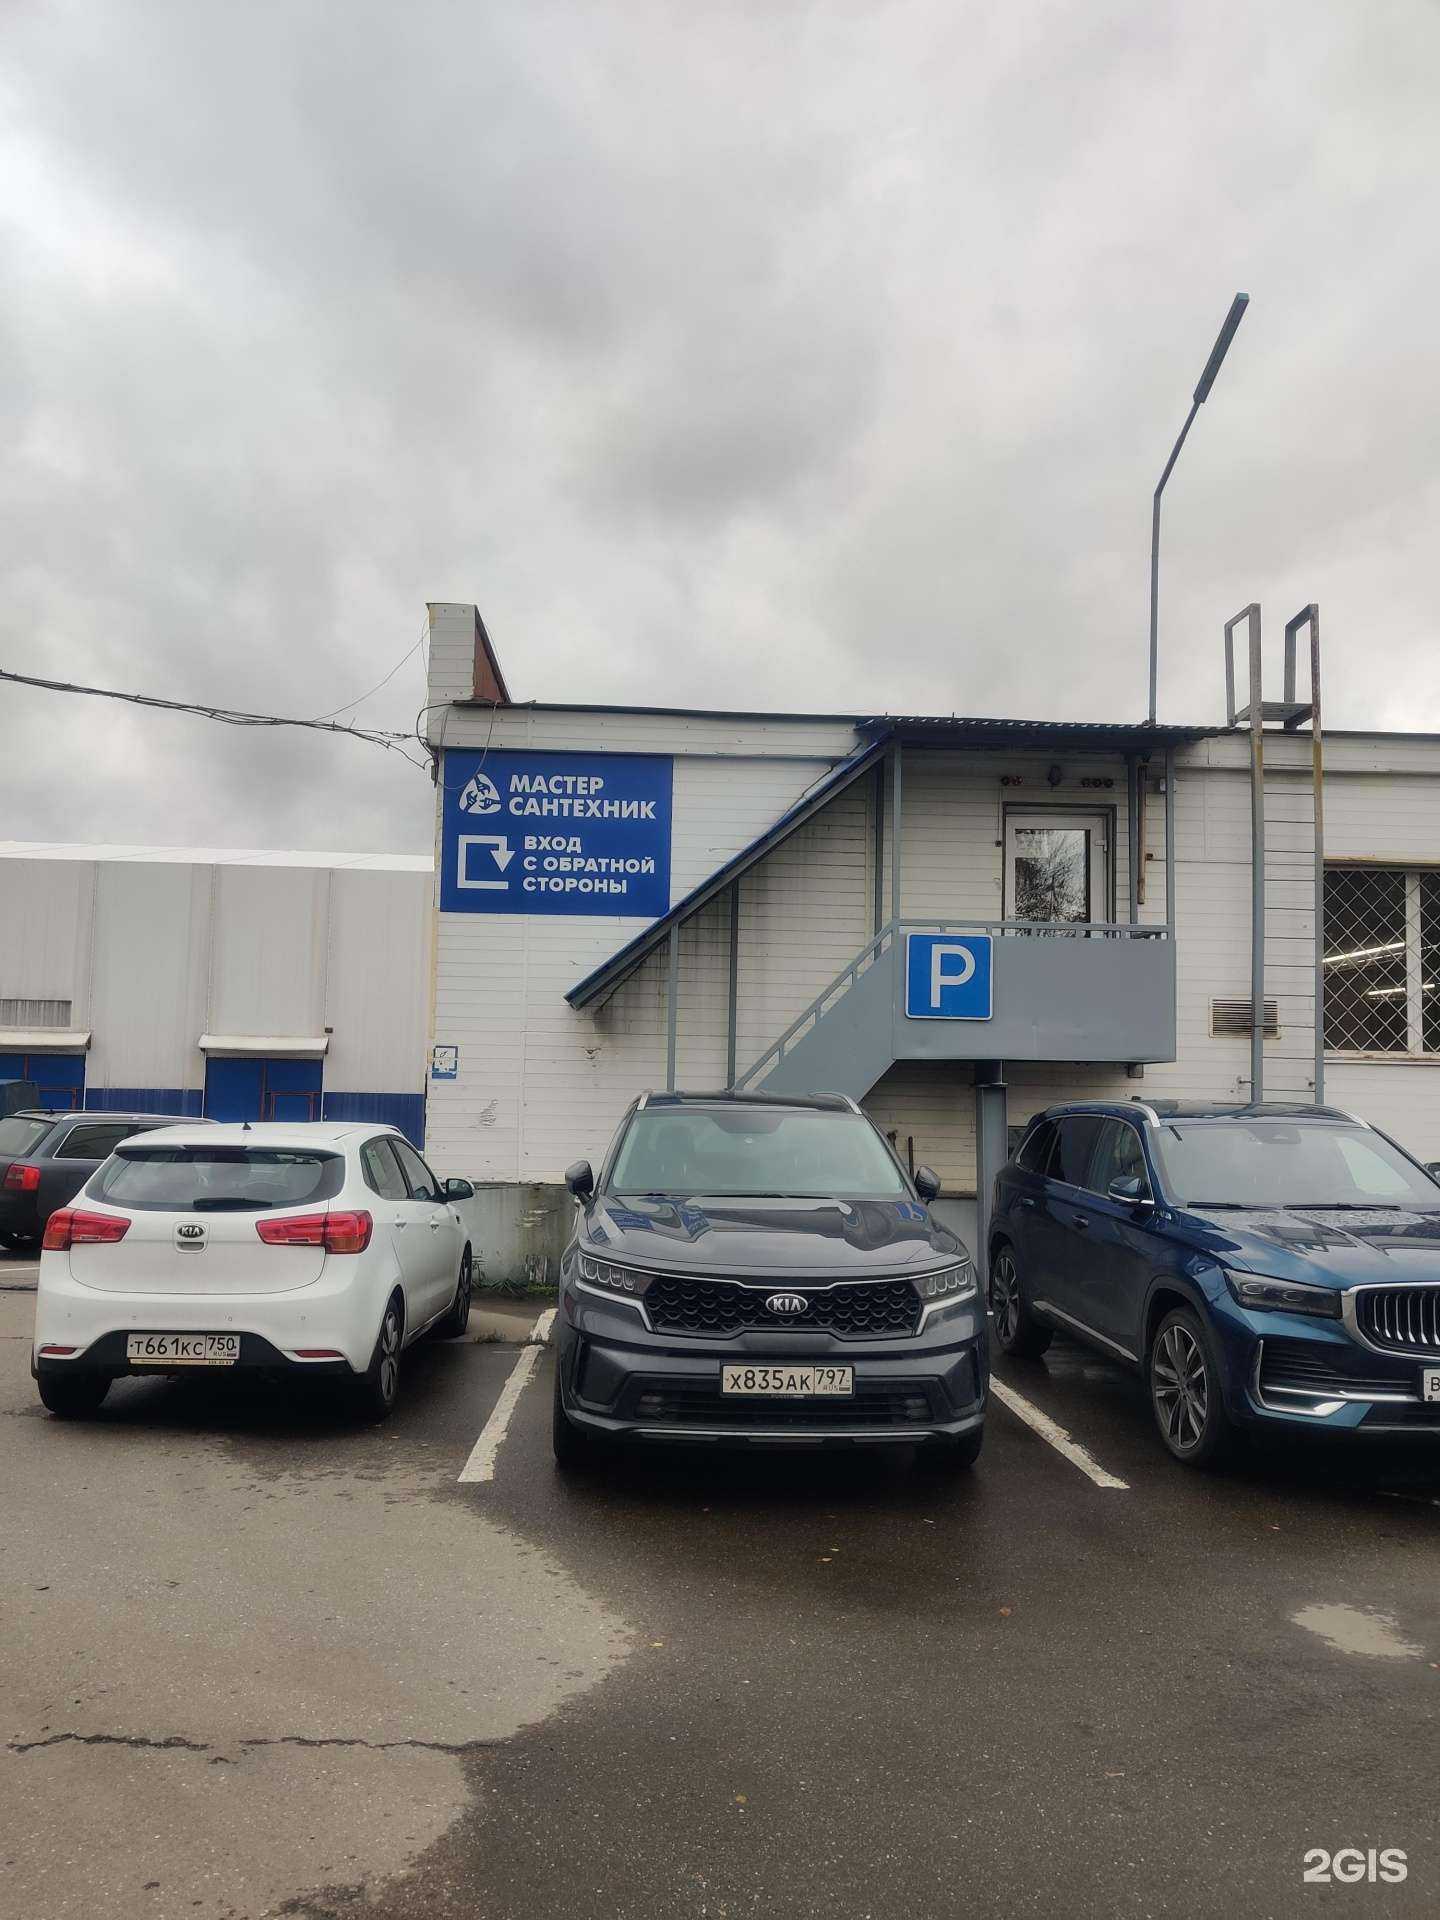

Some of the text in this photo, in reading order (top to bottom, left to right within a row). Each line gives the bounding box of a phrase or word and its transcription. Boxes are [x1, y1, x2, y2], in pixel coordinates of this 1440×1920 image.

[509, 774, 604, 795] МАСТЕР
[508, 796, 657, 819] САНТЕХНИК
[524, 835, 582, 853] ВХОД
[523, 856, 655, 874] С ОБРАТНОЙ
[522, 877, 627, 893] СТОРОНЫ
[930, 944, 976, 1008] P
[773, 1298, 801, 1311] KIA
[134, 1337, 236, 1356] Т661КС 750
[730, 1368, 846, 1391] Х835АК 797
